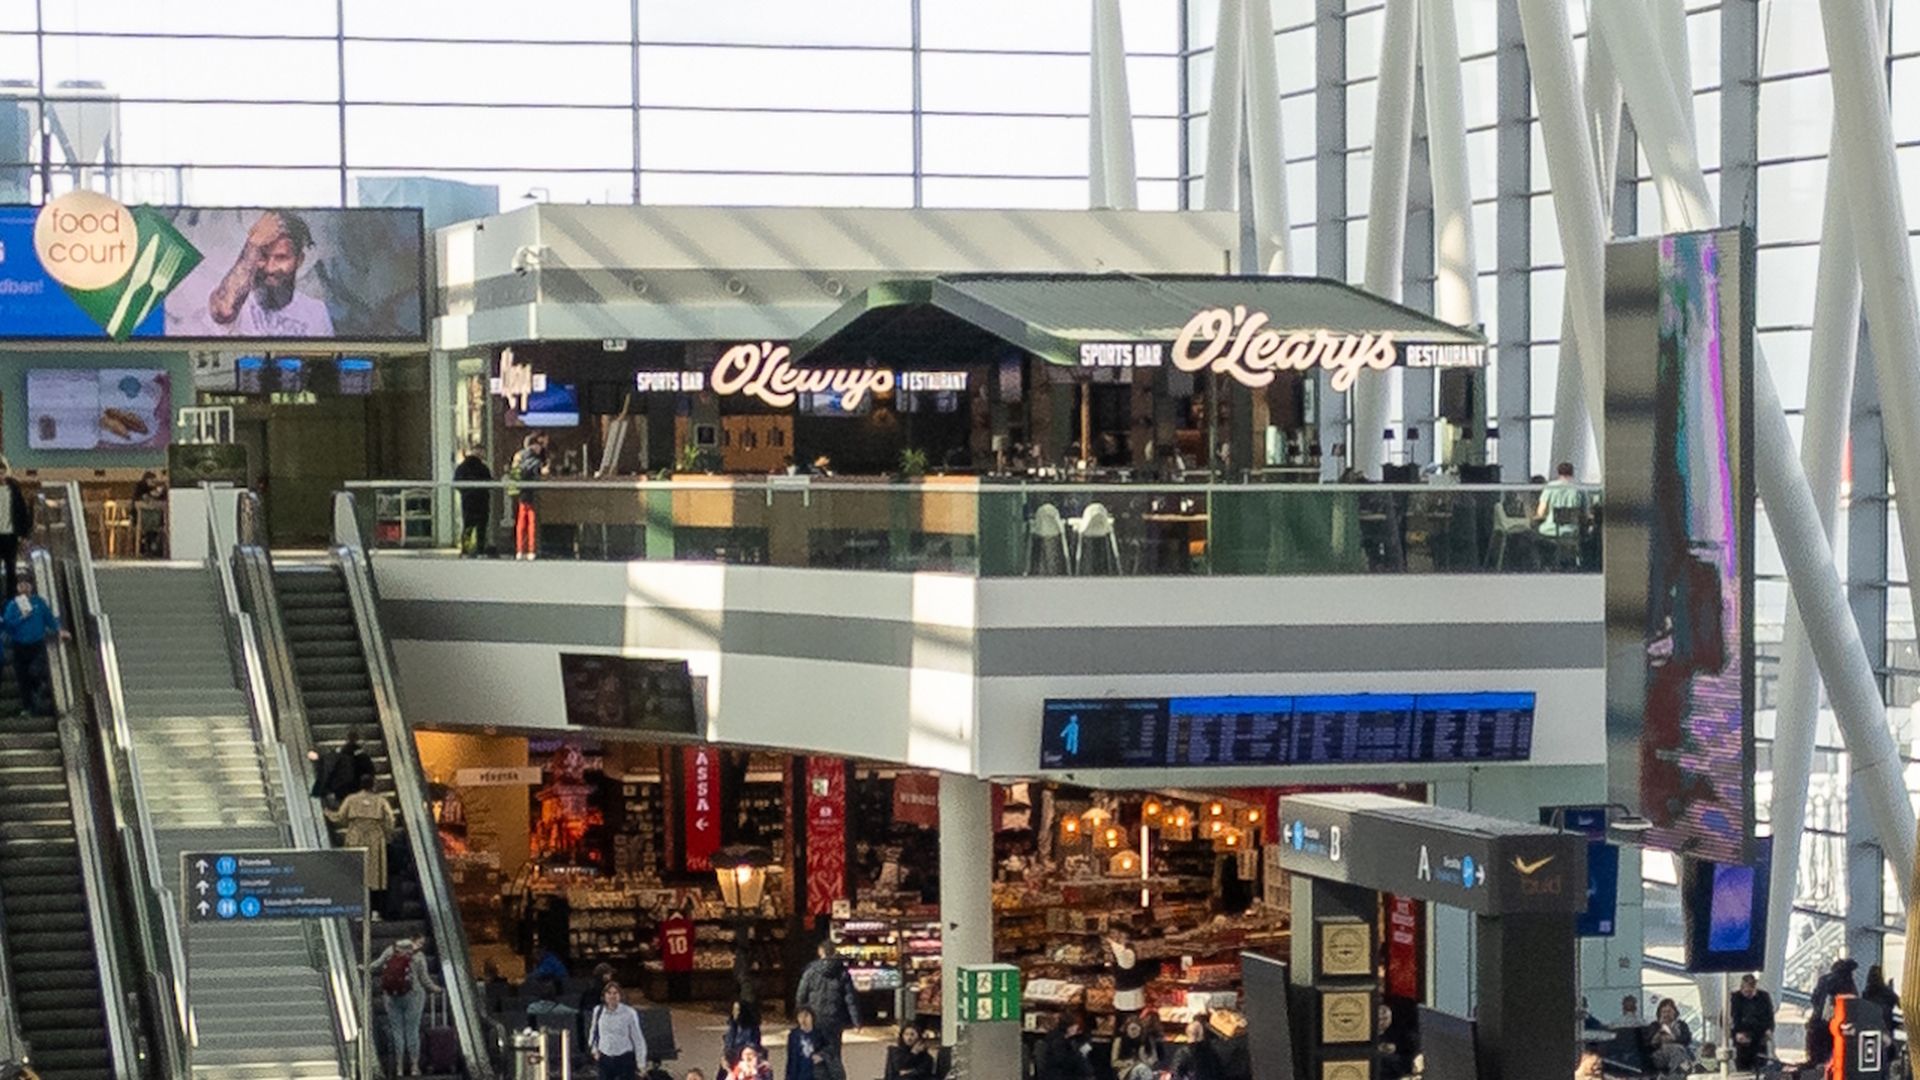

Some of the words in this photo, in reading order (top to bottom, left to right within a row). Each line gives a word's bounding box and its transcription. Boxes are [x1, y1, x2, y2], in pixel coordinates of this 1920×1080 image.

[52, 207, 120, 233] food
[48, 240, 126, 263] court
[1080, 343, 1133, 366] SPORTS
[1135, 344, 1163, 366] BAR
[1171, 305, 1397, 392] O'Learys
[1406, 344, 1486, 367] RESTAURANT
[637, 371, 680, 392] SPORTS
[681, 371, 704, 391] BAR
[695, 746, 710, 812] ASSA
[1330, 825, 1341, 862] B
[1417, 844, 1432, 882] A
[668, 936, 689, 955] 10
